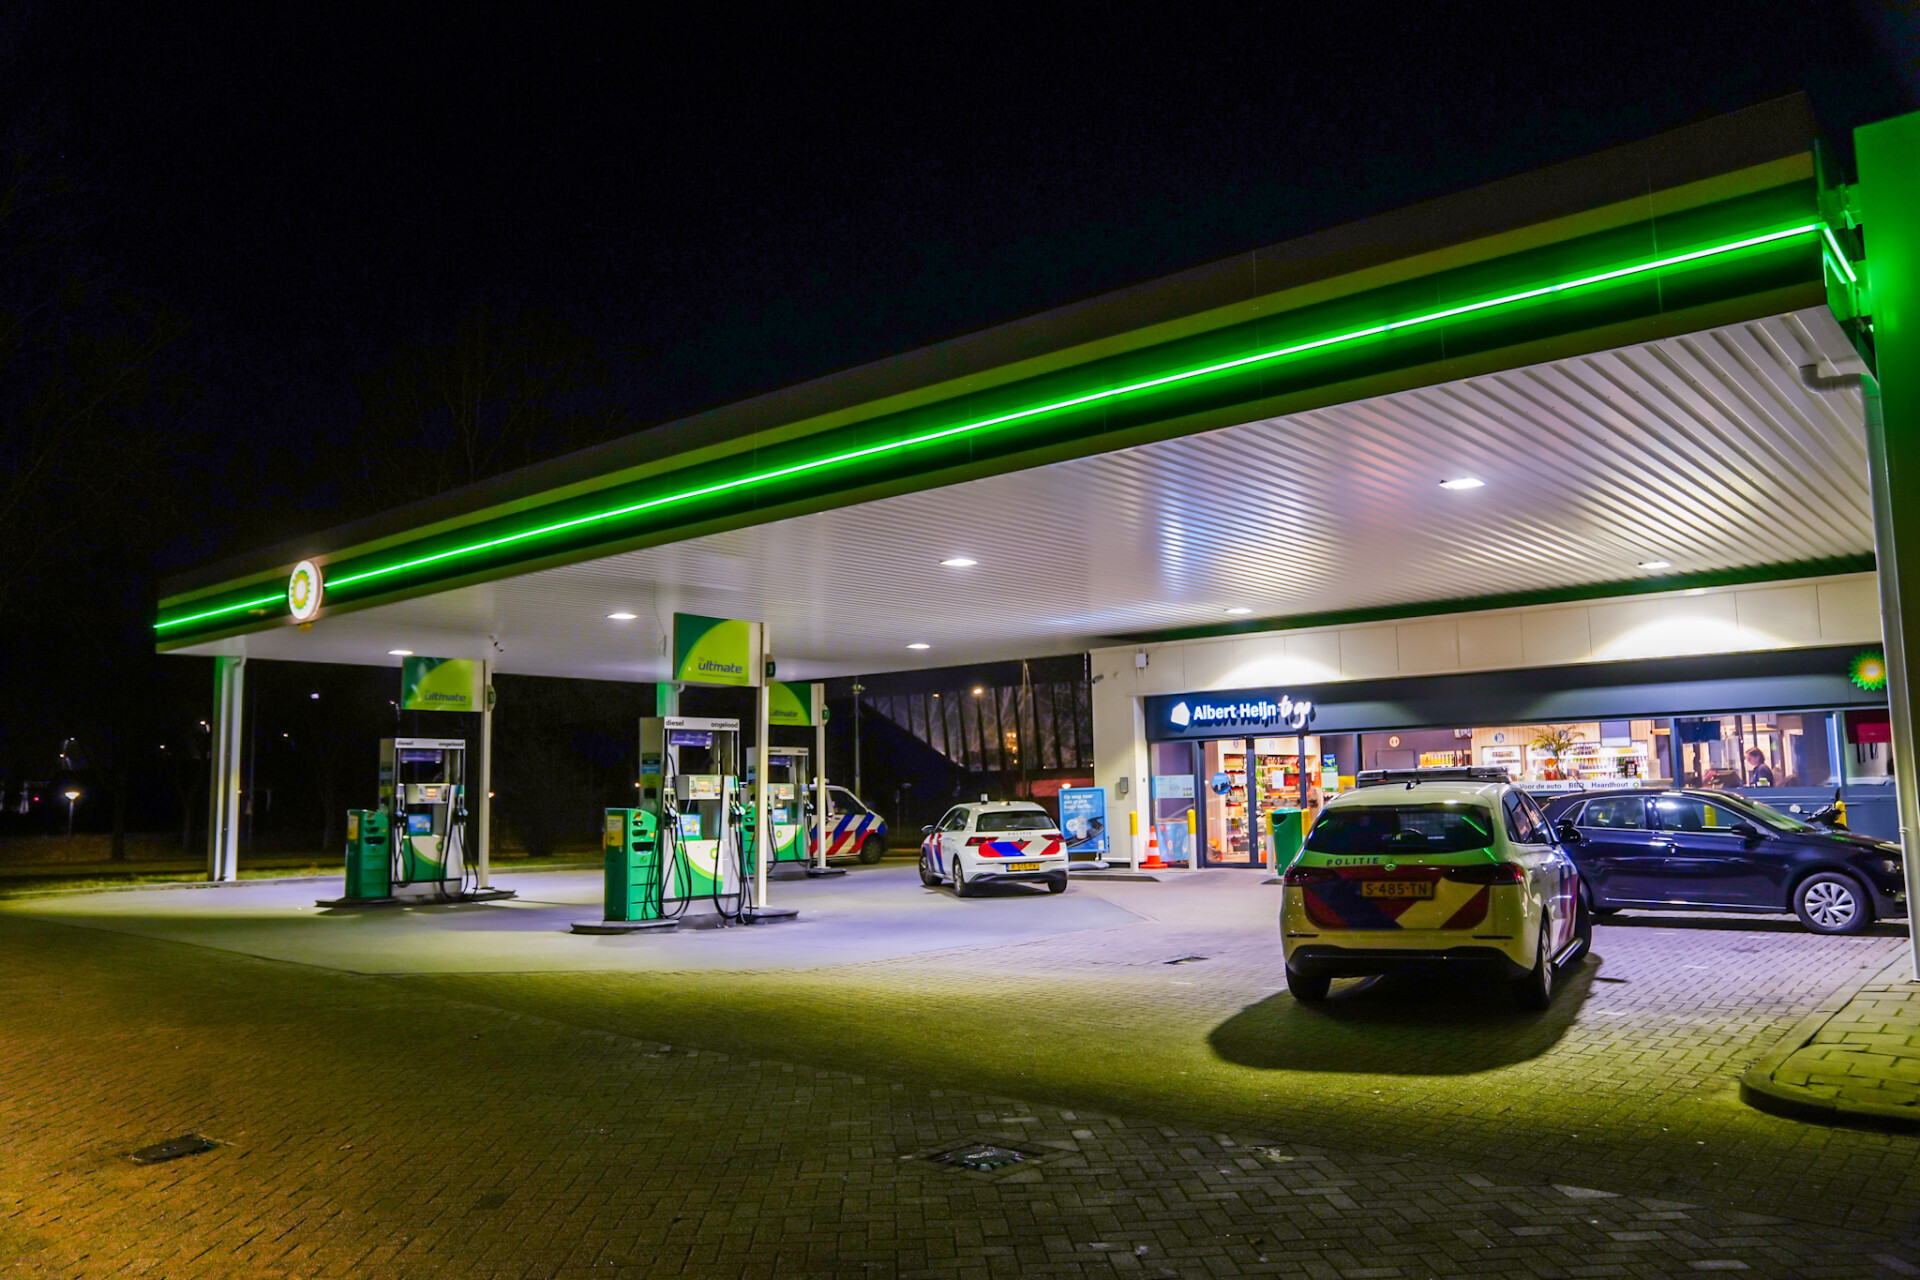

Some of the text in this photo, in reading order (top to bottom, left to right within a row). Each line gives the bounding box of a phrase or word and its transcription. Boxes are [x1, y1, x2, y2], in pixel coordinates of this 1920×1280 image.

[698, 661, 743, 674] ultimate
[424, 692, 466, 702] ultimate
[1193, 695, 1312, 729] Albert Heijn to go
[711, 721, 739, 729] ongelood
[1568, 782, 1584, 790] BBQ
[1326, 856, 1380, 867] POLITIE
[1365, 883, 1427, 896] S-485-TN
